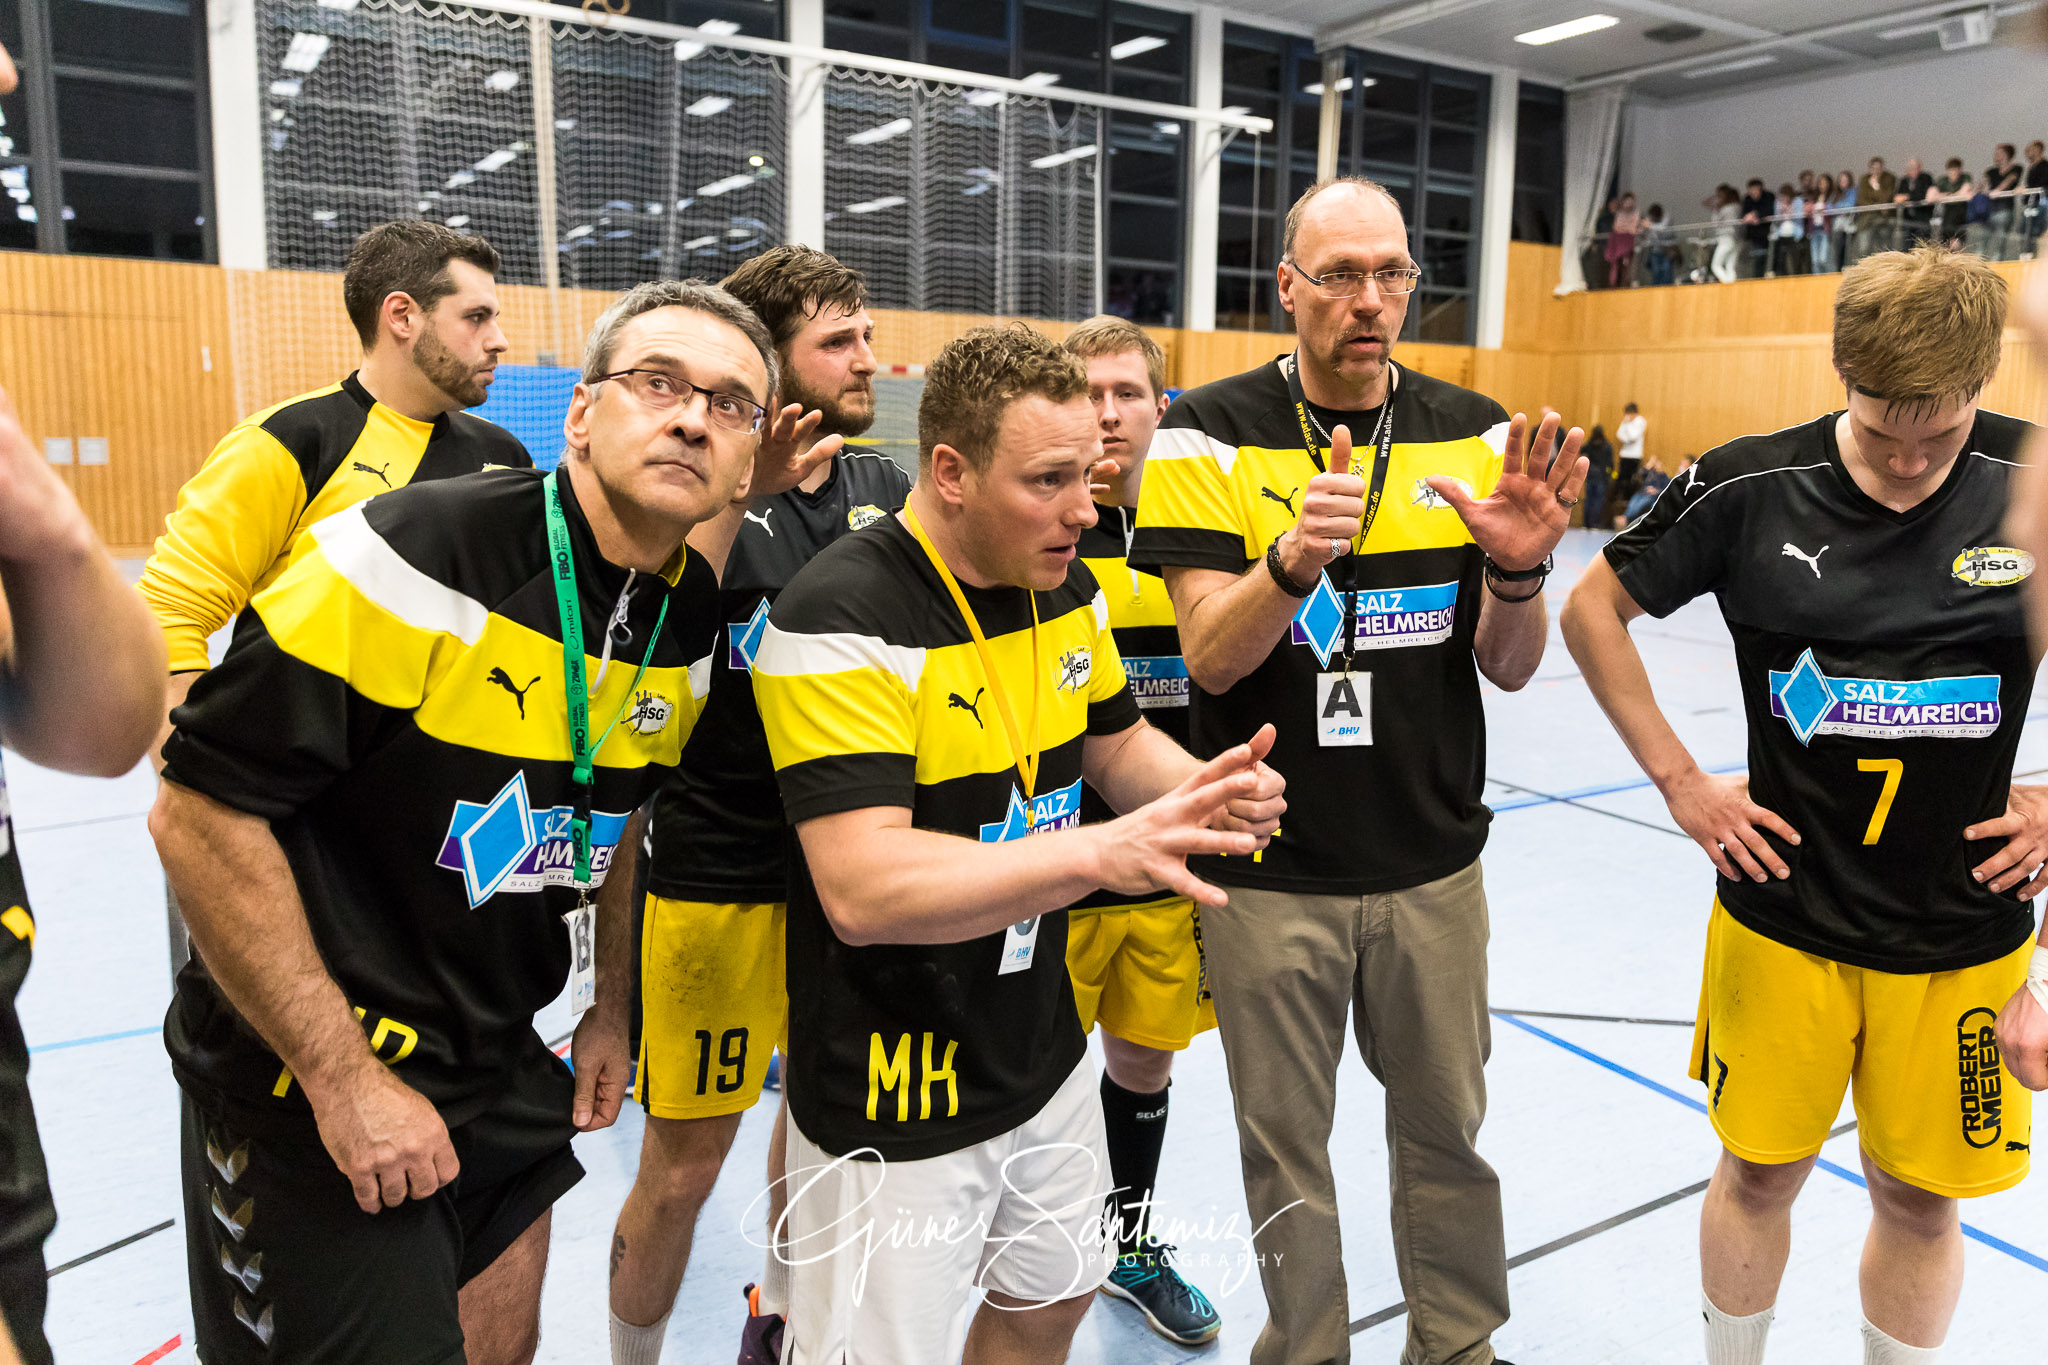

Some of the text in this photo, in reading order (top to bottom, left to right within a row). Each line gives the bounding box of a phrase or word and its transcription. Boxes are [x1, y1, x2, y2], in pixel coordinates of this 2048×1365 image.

[1295, 401, 1317, 456] www.adac.de
[556, 551, 571, 581] FIBO
[1971, 559, 2018, 571] HSG
[565, 600, 576, 635] milon
[1356, 592, 1404, 615] SALZ
[1354, 605, 1453, 635] HELMREICH
[1068, 658, 1090, 678] HSG
[1124, 661, 1152, 678] ALZ
[1322, 679, 1364, 719] A
[1843, 682, 1909, 704] SALZ
[638, 706, 665, 721] HSG
[1842, 702, 1995, 724] HELMREICH
[574, 728, 586, 756] FIBO
[1338, 726, 1361, 735] BHV
[1856, 757, 1904, 846] 7
[695, 1026, 749, 1096] 19
[1957, 1026, 1981, 1133] ROBERT
[1978, 1025, 2002, 1131] MEIER
